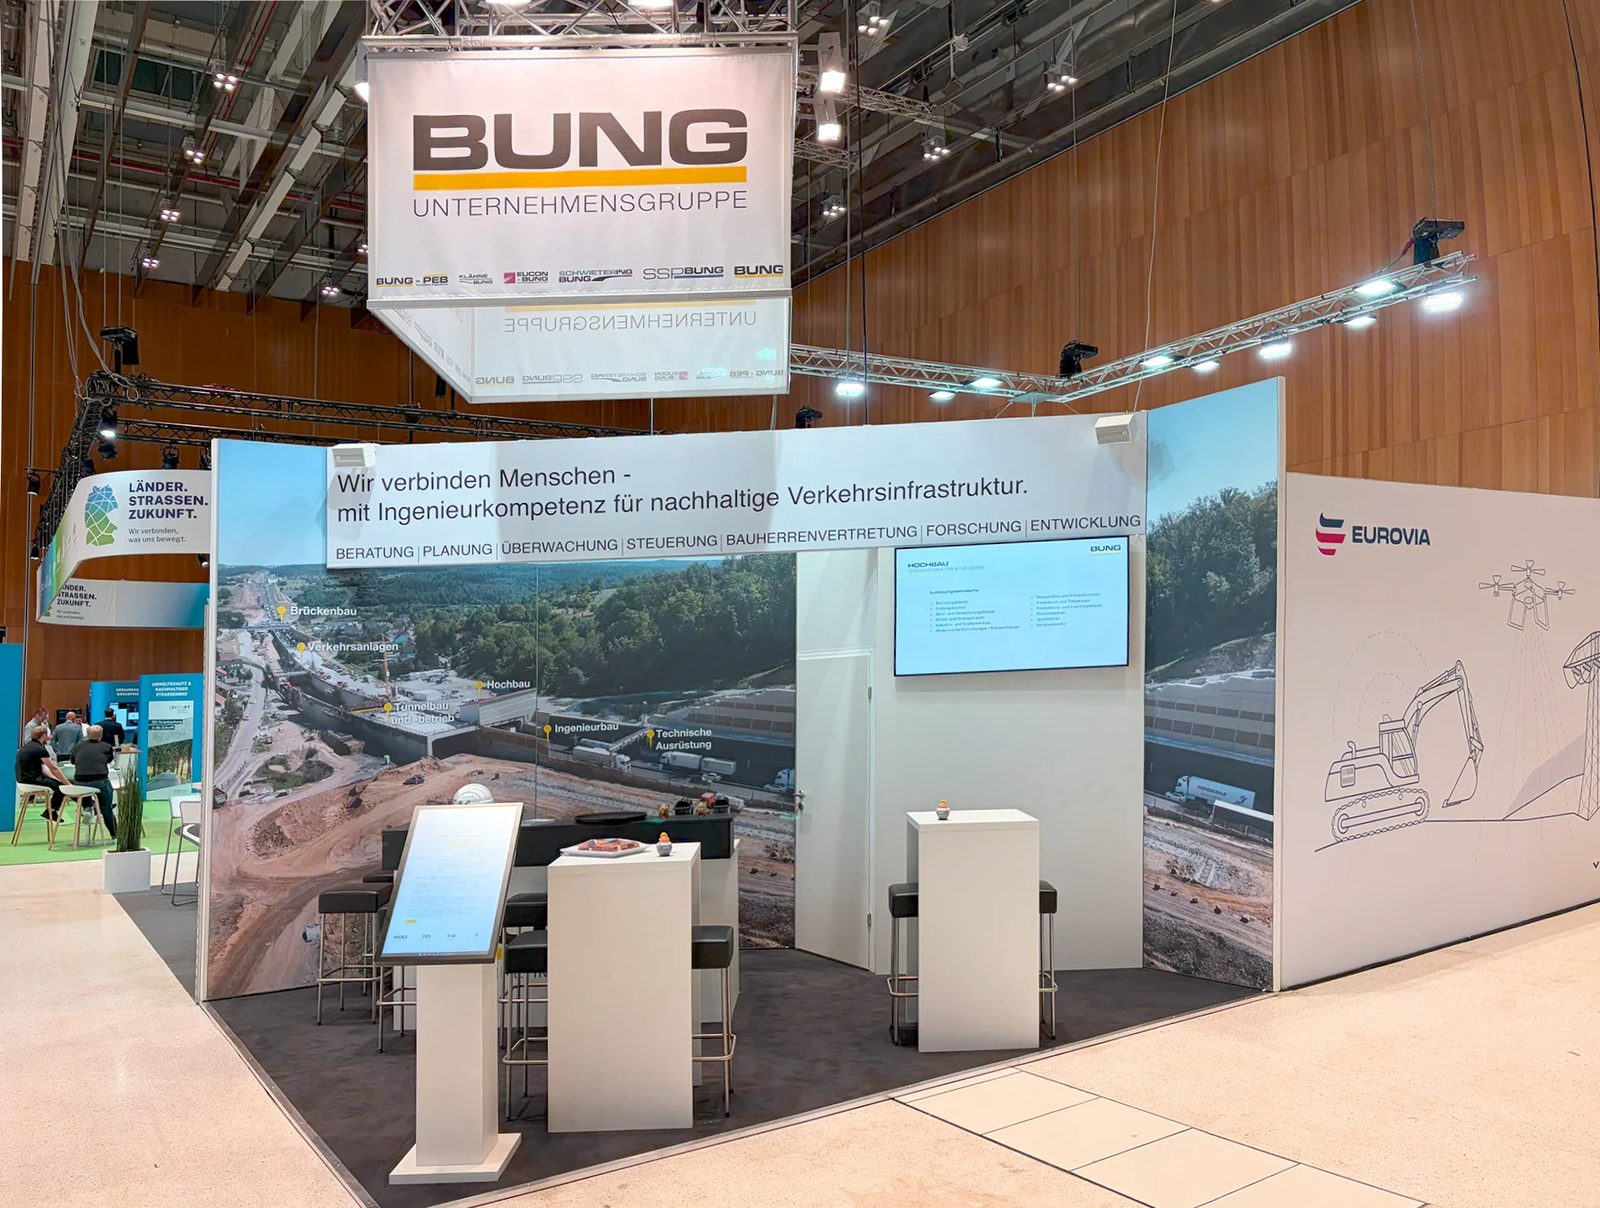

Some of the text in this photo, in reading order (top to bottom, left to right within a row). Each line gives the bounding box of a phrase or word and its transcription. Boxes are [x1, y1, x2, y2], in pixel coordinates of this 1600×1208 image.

[413, 108, 748, 171] BUNG
[413, 190, 748, 218] UNTERNEHMENSGRUPPE
[559, 268, 633, 276] SCHWIETERING
[734, 264, 784, 275] BUNG
[376, 277, 413, 286] BUNG
[423, 276, 449, 284] PEB
[559, 275, 591, 283] BUNG
[338, 473, 374, 493] Wir
[382, 470, 491, 492] verbinden
[500, 467, 616, 488] Menschen
[129, 480, 188, 492] LÄNDER.
[129, 495, 208, 506] STRASSEN.
[337, 477, 1027, 526] mit Ingenieurkompetenz für nachhaltige Verkehrsinfrastruktur.
[128, 509, 197, 520] ZUKUNFT.
[140, 527, 178, 535] verbinden,
[1351, 524, 1431, 547] EUROVIA
[336, 514, 1141, 560] BERATUNG PLANUNG ÜBERWACHUNG STEUERUNG BAUHERRENVERTRETUNG FORSCHUNG ENTWICKLUNG
[1090, 544, 1121, 552] BUNG
[57, 598, 92, 607] ZUKUNFT.
[290, 605, 357, 616] Brückenbau
[308, 641, 399, 652] Verkehrsanlagen
[487, 679, 531, 689] Hochbau
[395, 701, 449, 711] Tunnelbau
[391, 713, 454, 724] und -betrieb
[554, 722, 619, 733] Ingenieurbau
[655, 728, 712, 738] Technische
[655, 740, 712, 751] Ausrüstung
